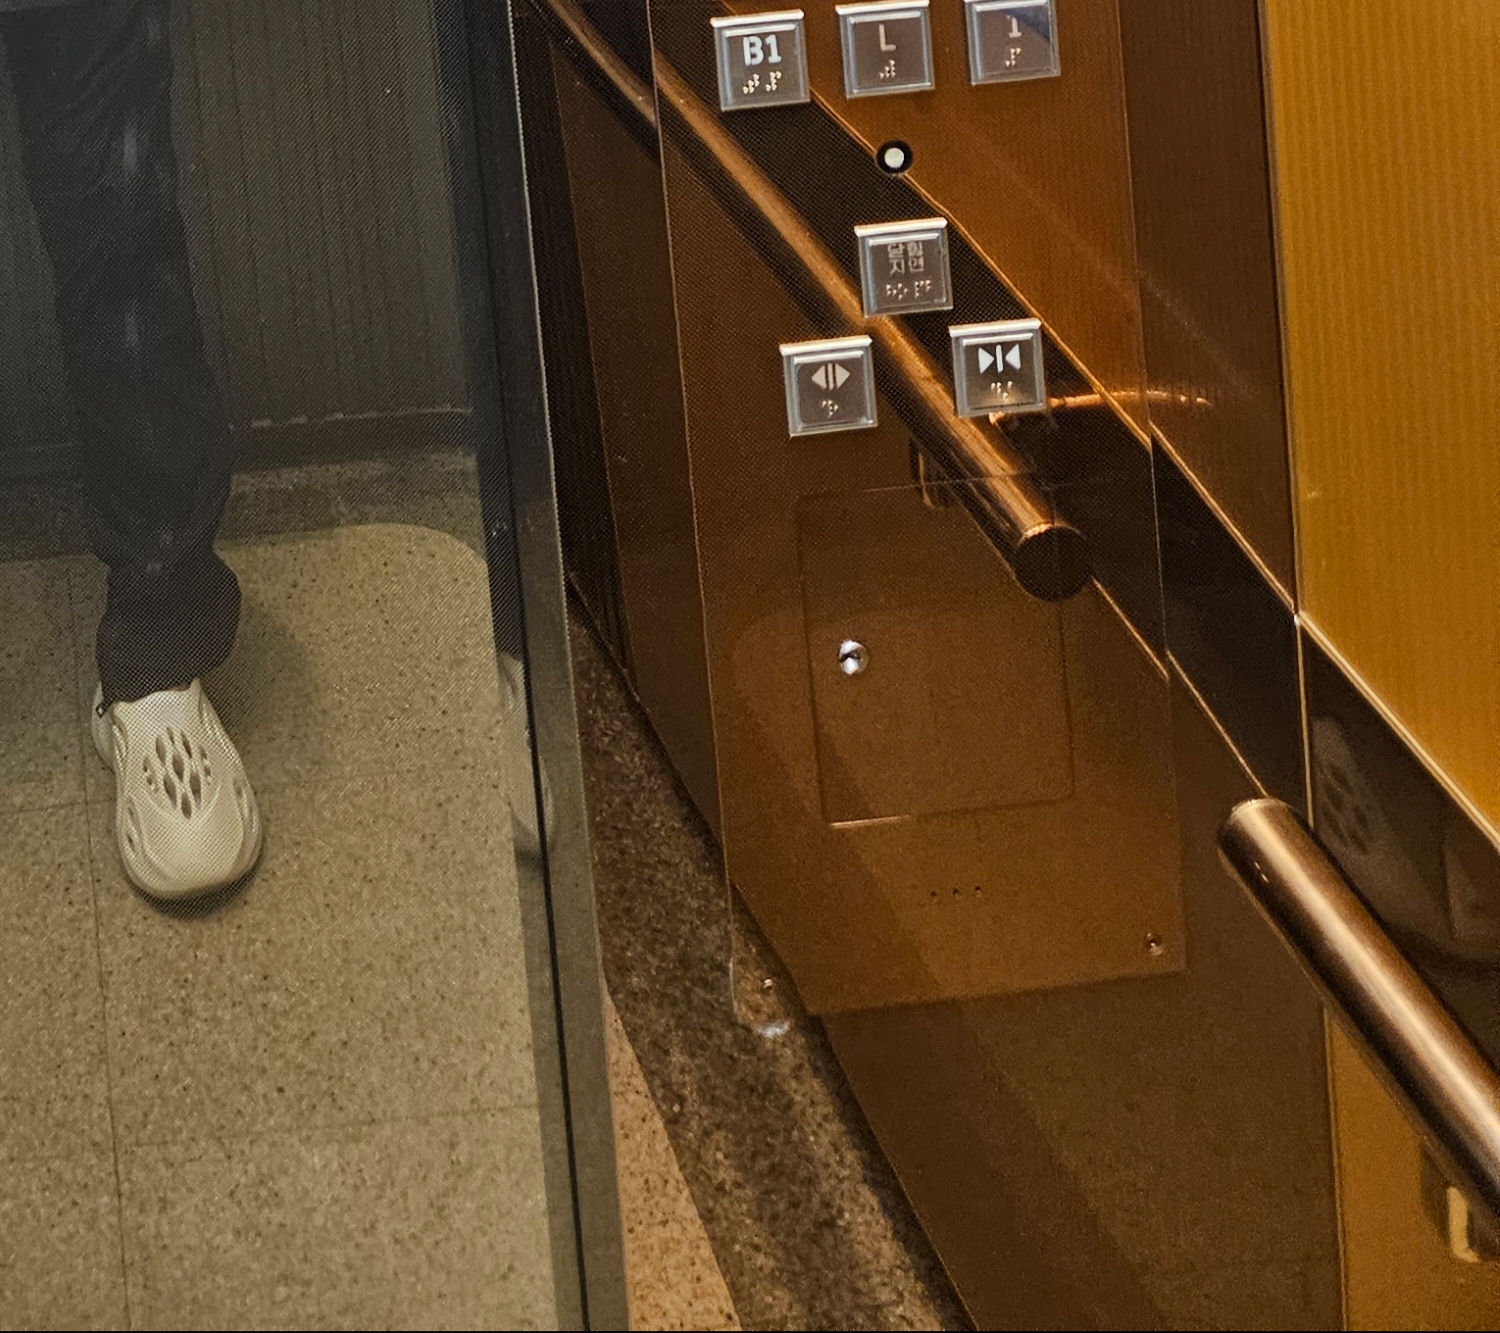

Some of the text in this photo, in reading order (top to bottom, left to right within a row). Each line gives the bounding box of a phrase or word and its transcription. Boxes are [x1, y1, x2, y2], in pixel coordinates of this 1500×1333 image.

[879, 24, 896, 51] L
[1007, 14, 1022, 37] 1
[743, 35, 782, 65] B1
